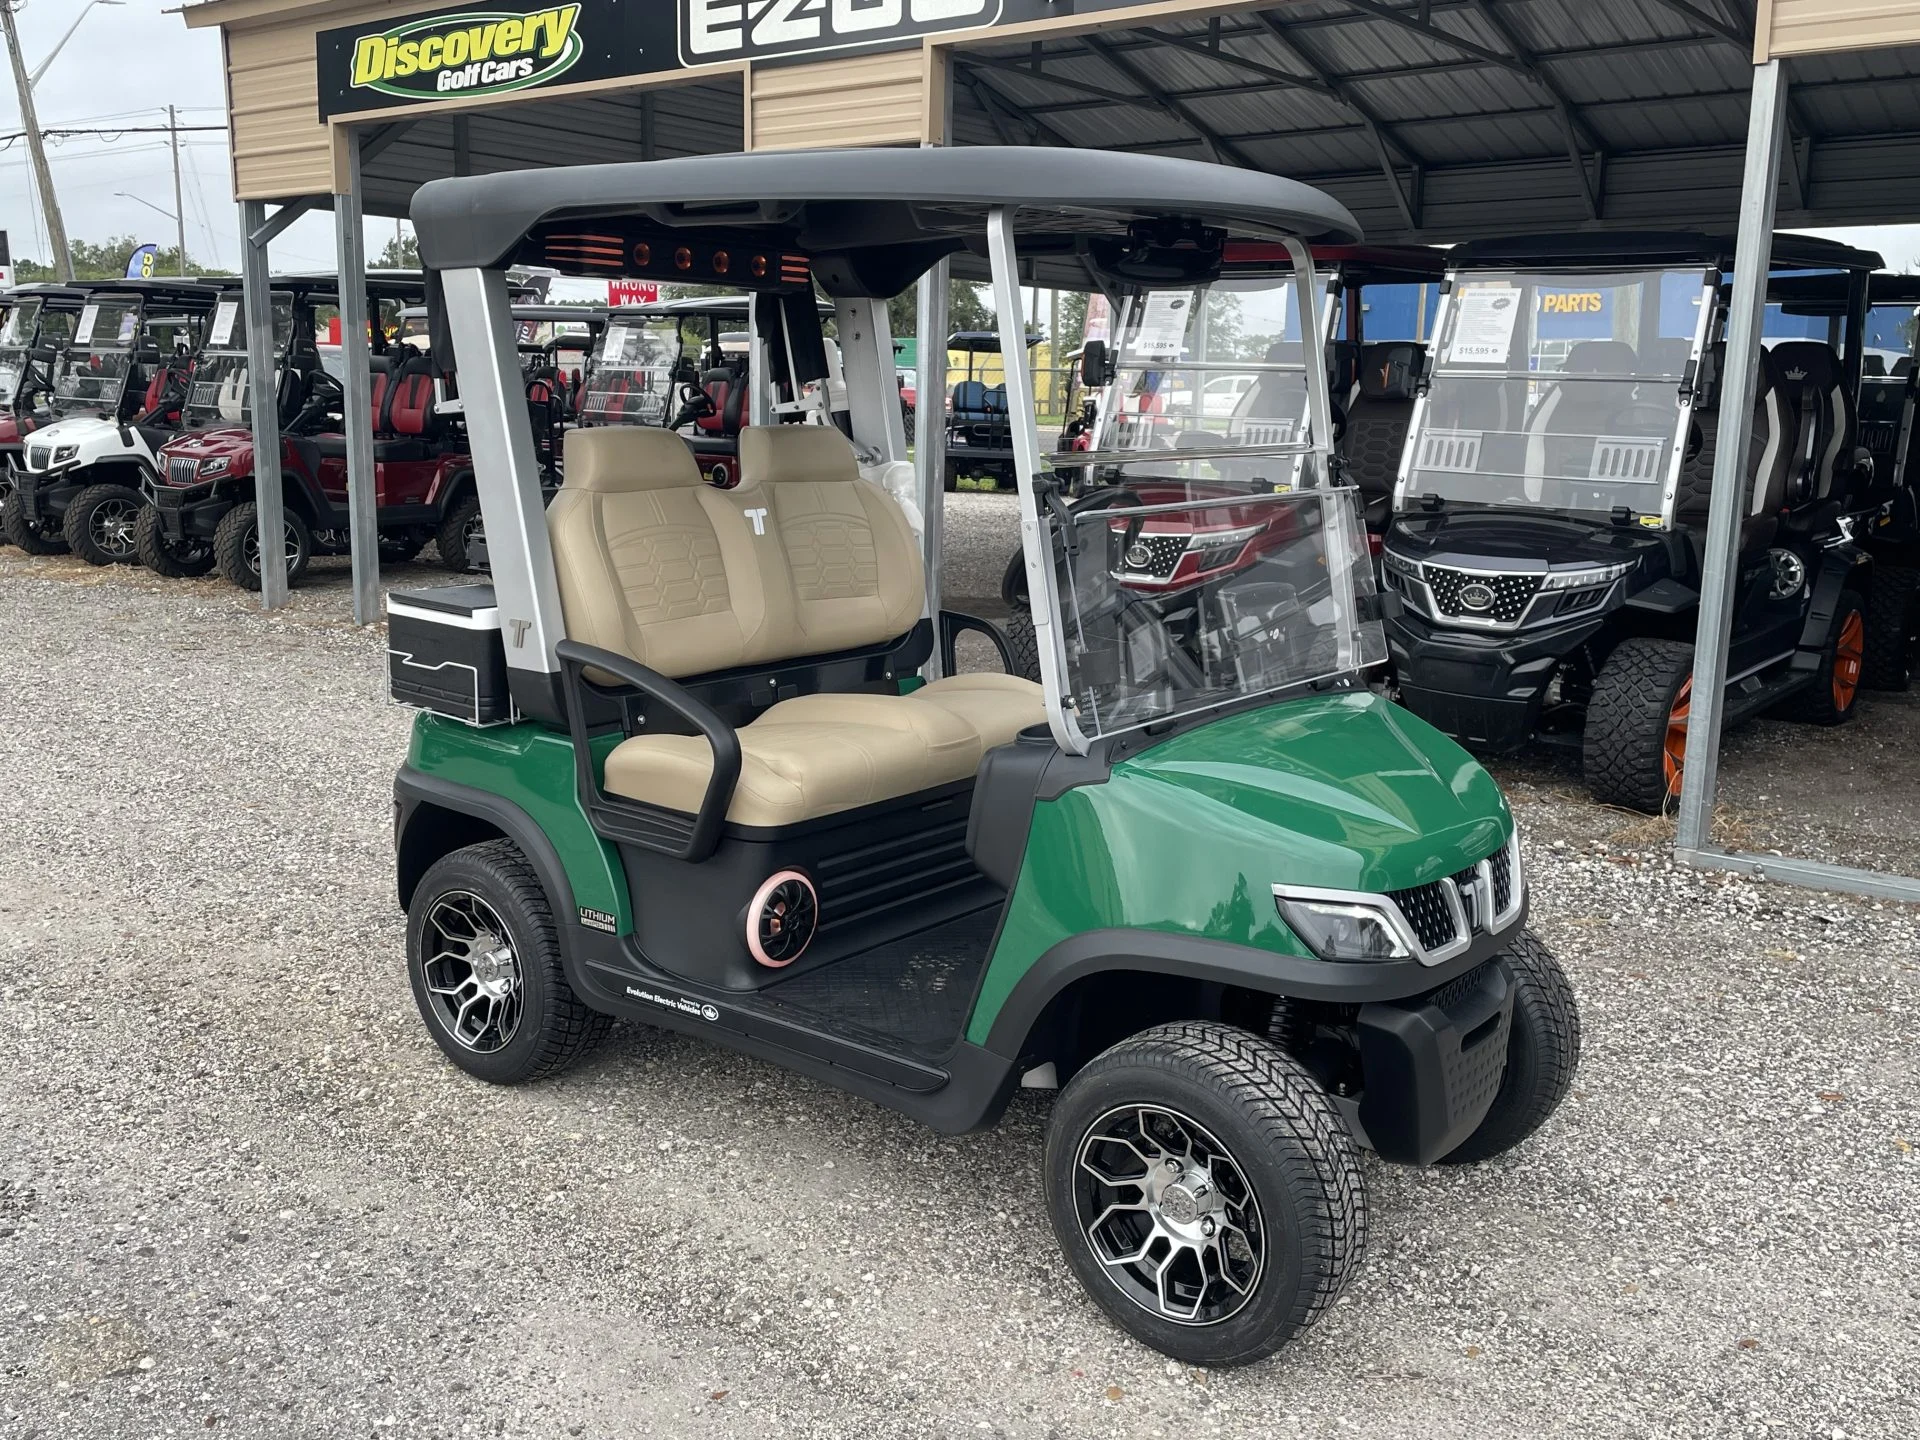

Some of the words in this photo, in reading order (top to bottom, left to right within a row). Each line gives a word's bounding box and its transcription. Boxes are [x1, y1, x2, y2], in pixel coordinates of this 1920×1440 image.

[354, 6, 577, 85] Discovery
[437, 61, 480, 91] Golf
[481, 57, 533, 82] Cars
[611, 280, 655, 293] WRONG
[619, 294, 647, 306] WAY
[1543, 292, 1602, 312] PARTS
[1458, 347, 1489, 355] $15,595
[580, 907, 615, 925] LITHIUM
[626, 986, 654, 1001] Evolution
[654, 995, 676, 1008] Electric
[676, 1001, 701, 1016] Vehicles
